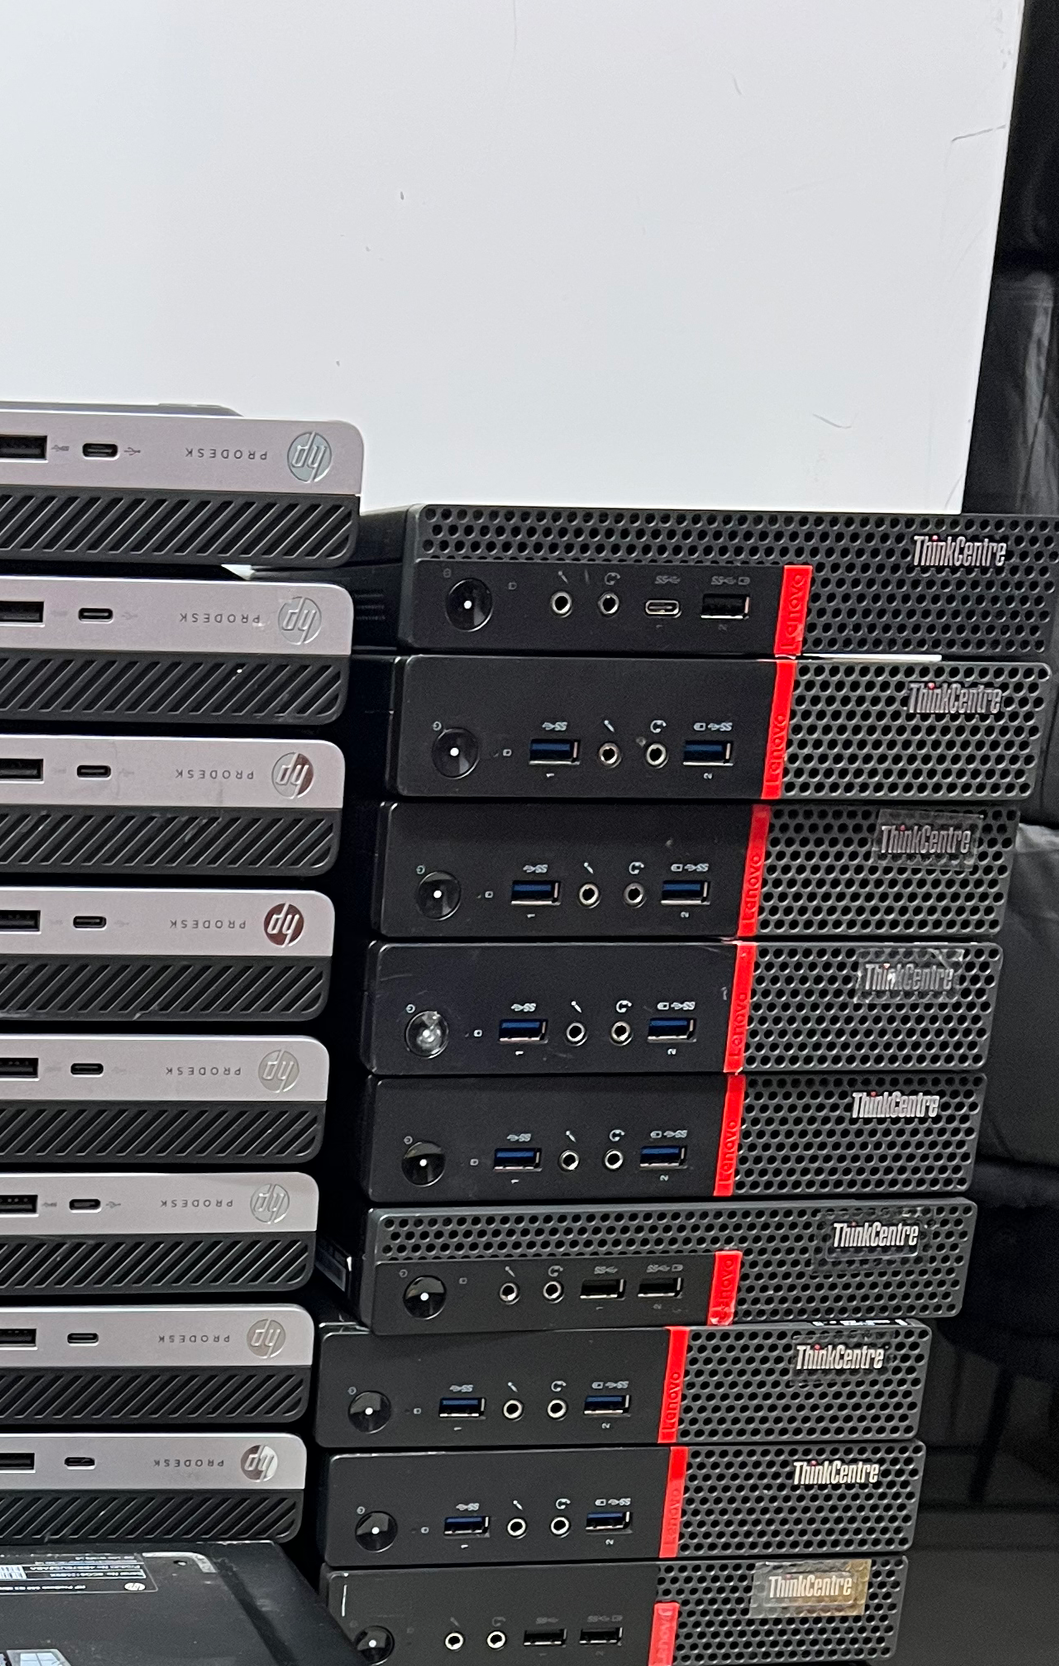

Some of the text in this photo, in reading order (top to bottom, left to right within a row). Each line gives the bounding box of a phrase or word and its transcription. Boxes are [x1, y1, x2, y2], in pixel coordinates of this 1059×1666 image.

[185, 447, 268, 460] PRODESK
[913, 535, 1007, 567] ThinkCentre
[179, 613, 260, 623] PRODESK
[908, 681, 1002, 714] ThinkCentre
[175, 769, 254, 780] PRODESK
[881, 825, 971, 853] ThinkCentre
[169, 920, 246, 929] PRODESK
[865, 963, 954, 990] ThinkCentre
[165, 1067, 241, 1076] PRODESK
[852, 1091, 940, 1118] ThinkCentre
[160, 1199, 233, 1208] PRODESK
[833, 1220, 919, 1247] ThinkCentre
[158, 1335, 230, 1343] PRODESK
[796, 1344, 884, 1370] ThinkCentre
[153, 1459, 224, 1467] PRODESK
[793, 1460, 880, 1485] ThinkCentre
[768, 1573, 852, 1598] ThinkCentre
